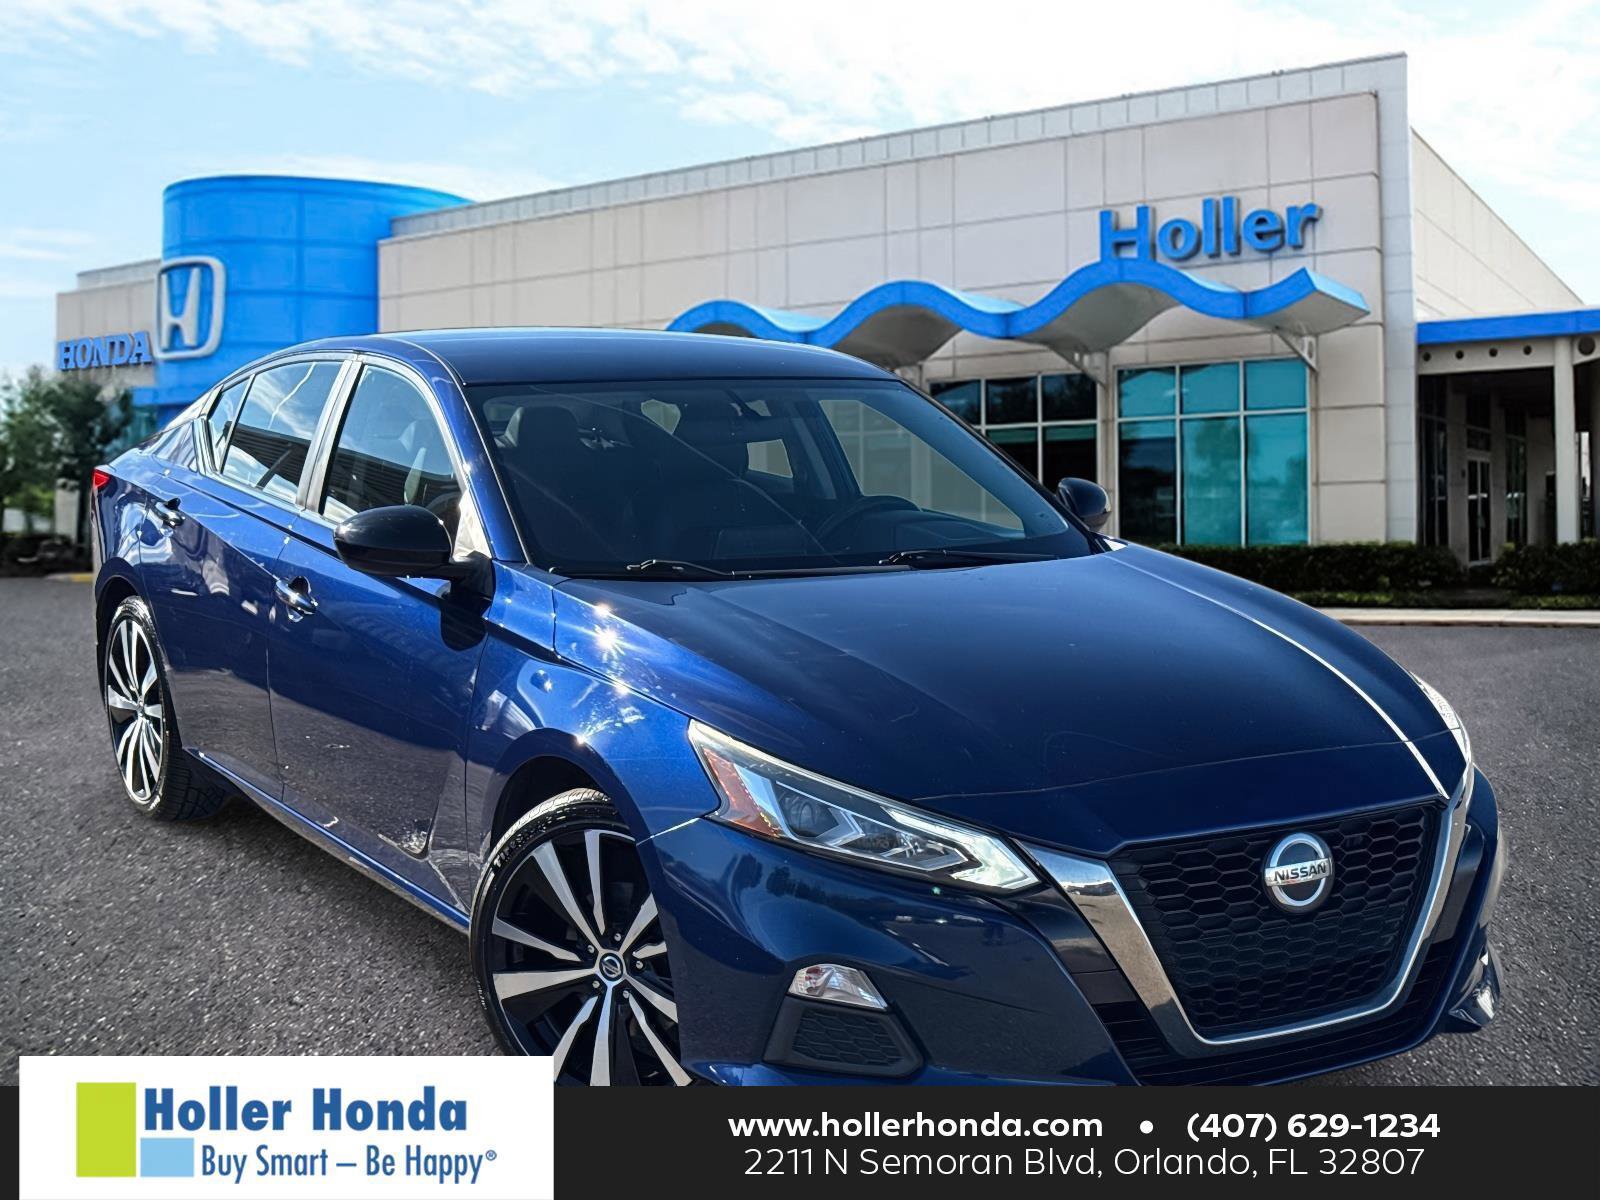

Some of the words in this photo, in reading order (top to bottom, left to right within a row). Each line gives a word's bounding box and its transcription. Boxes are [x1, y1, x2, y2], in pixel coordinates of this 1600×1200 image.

[1099, 195, 1322, 262] Holler
[58, 330, 153, 371] HONDA
[1273, 862, 1327, 881] NISSAN
